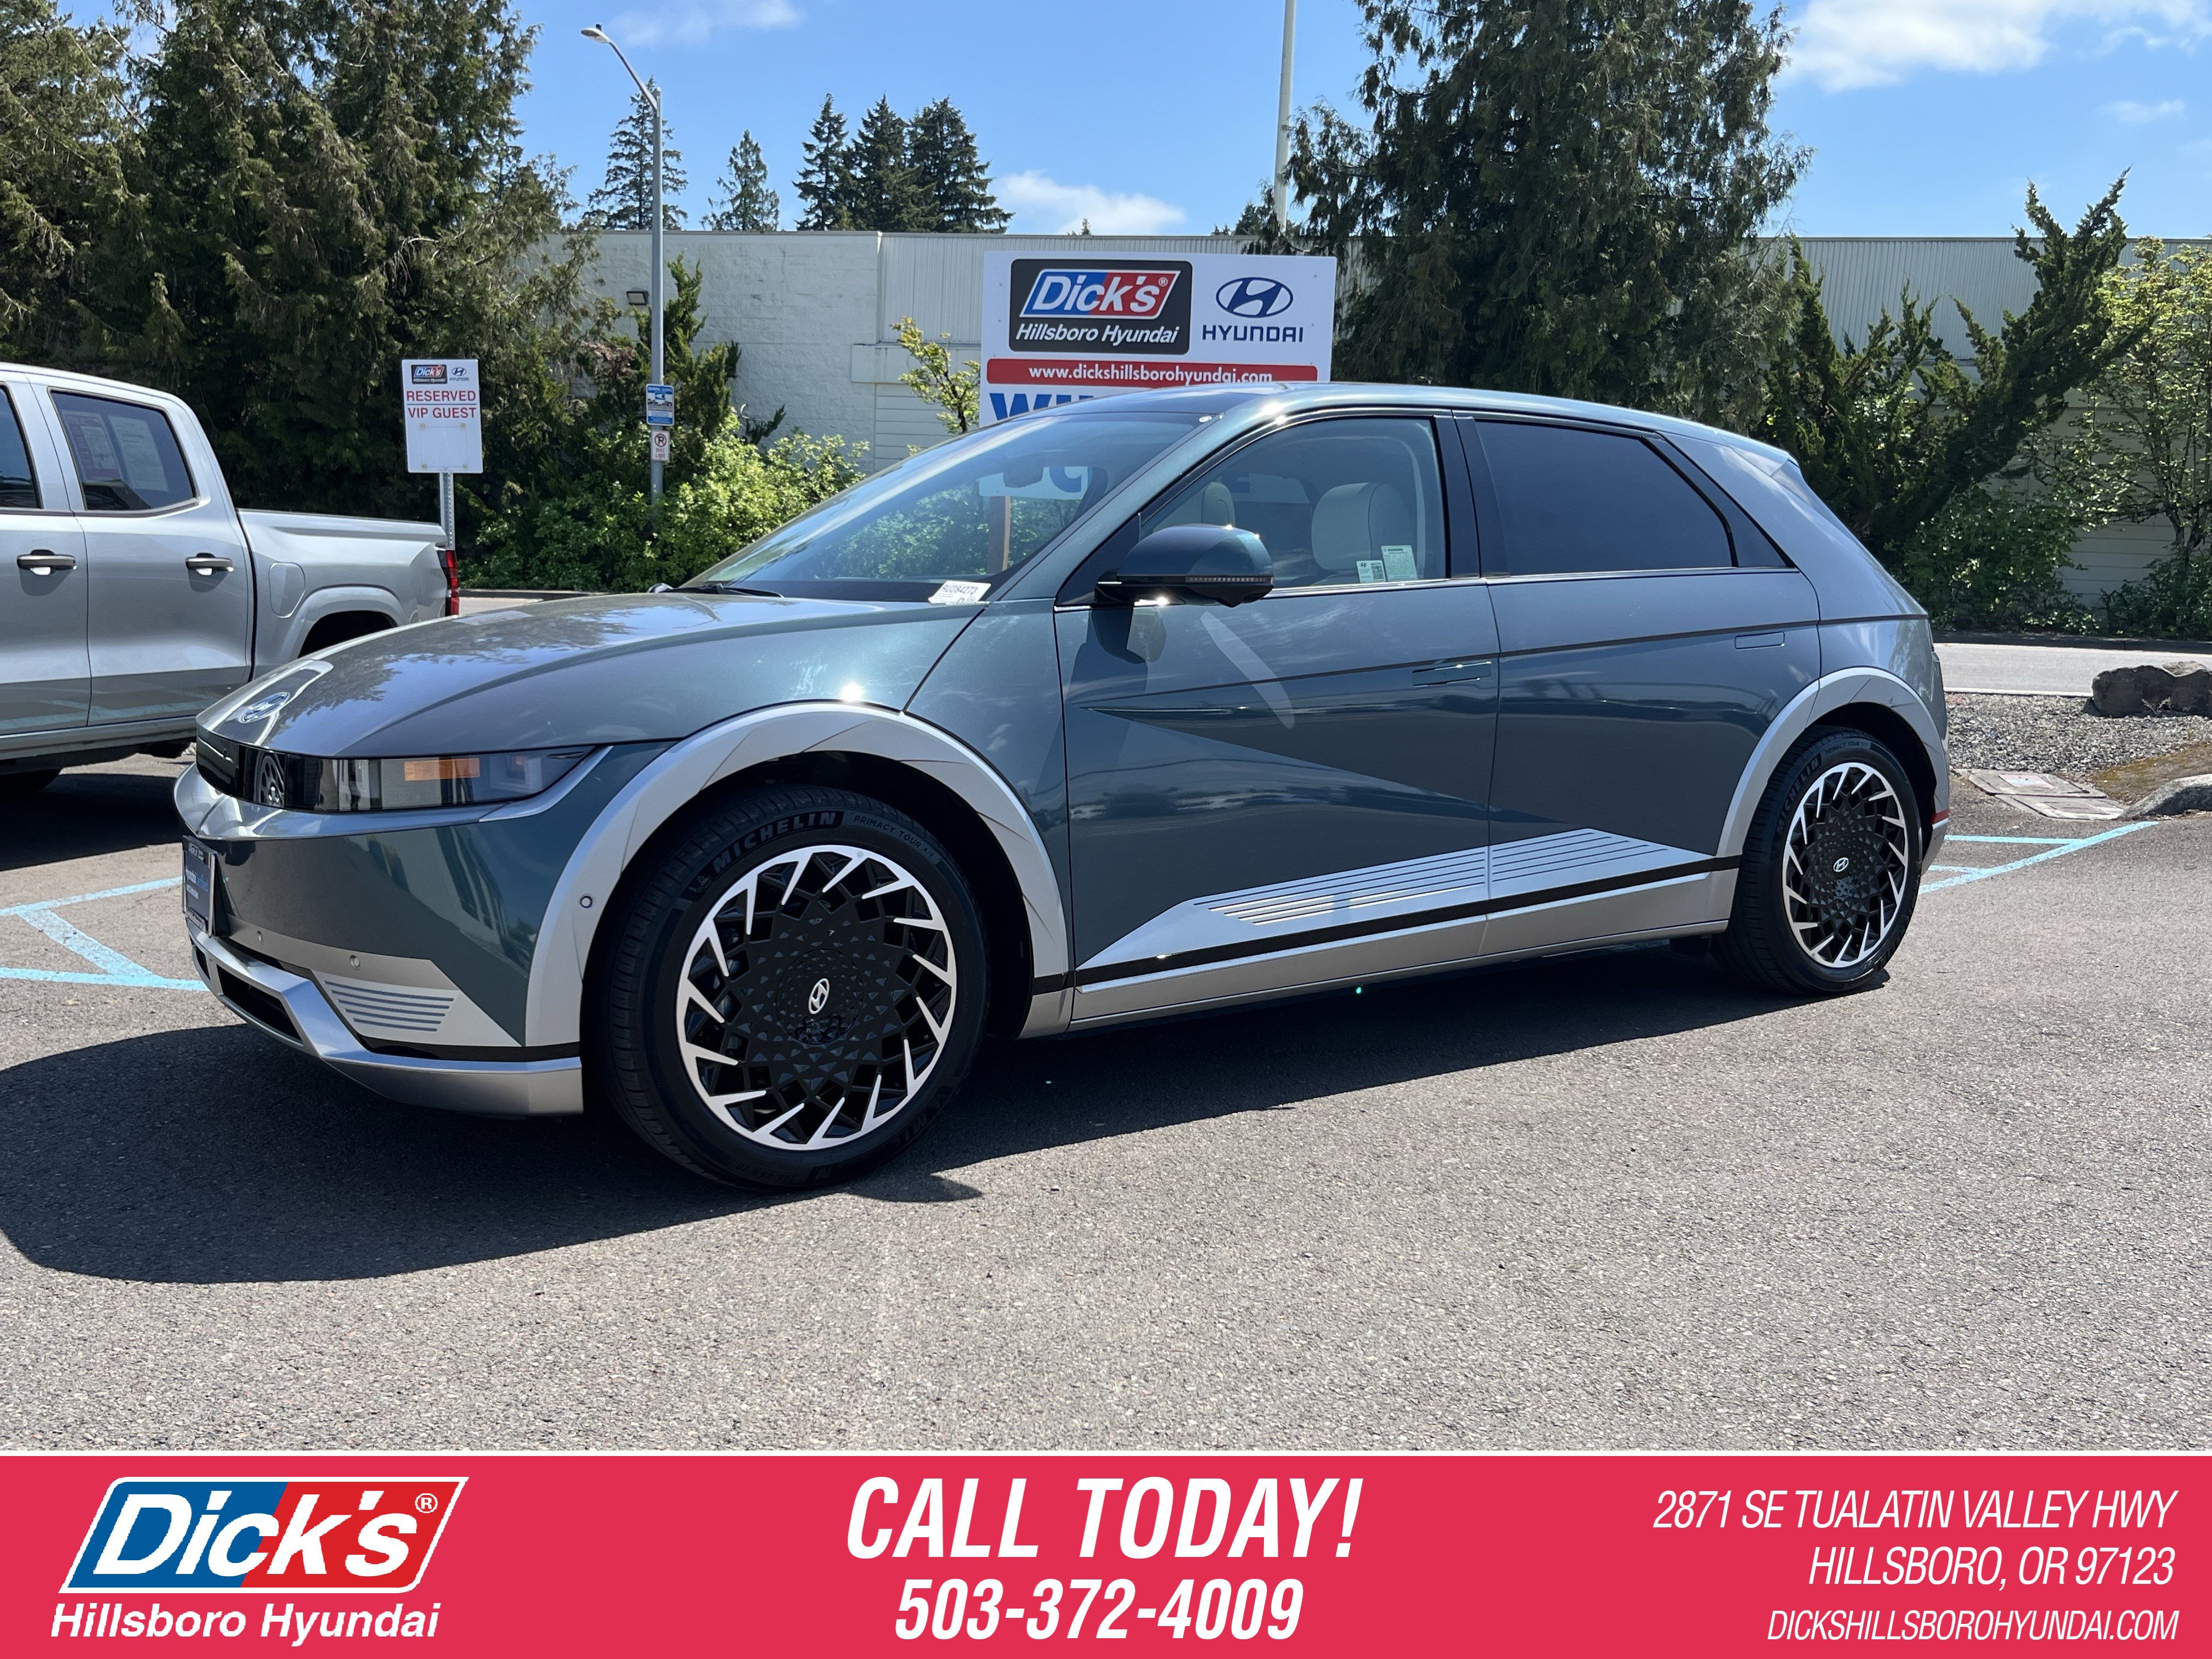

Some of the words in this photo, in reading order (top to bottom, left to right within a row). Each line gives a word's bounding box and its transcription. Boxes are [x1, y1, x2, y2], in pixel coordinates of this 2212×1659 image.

[1032, 275, 1160, 313] Dick's
[1015, 324, 1099, 341] Hillsboro
[1102, 325, 1180, 346] Hyundai
[1203, 325, 1303, 343] HYUNDAI
[416, 368, 441, 376] Dick's
[407, 391, 476, 402] RESERVED
[408, 408, 428, 418] VIP
[433, 408, 476, 418] GUEST
[1776, 756, 1819, 834] MICHELIN
[713, 812, 836, 873] MICHELIN
[854, 815, 896, 833] PRIMACY
[898, 830, 922, 850] TOUR
